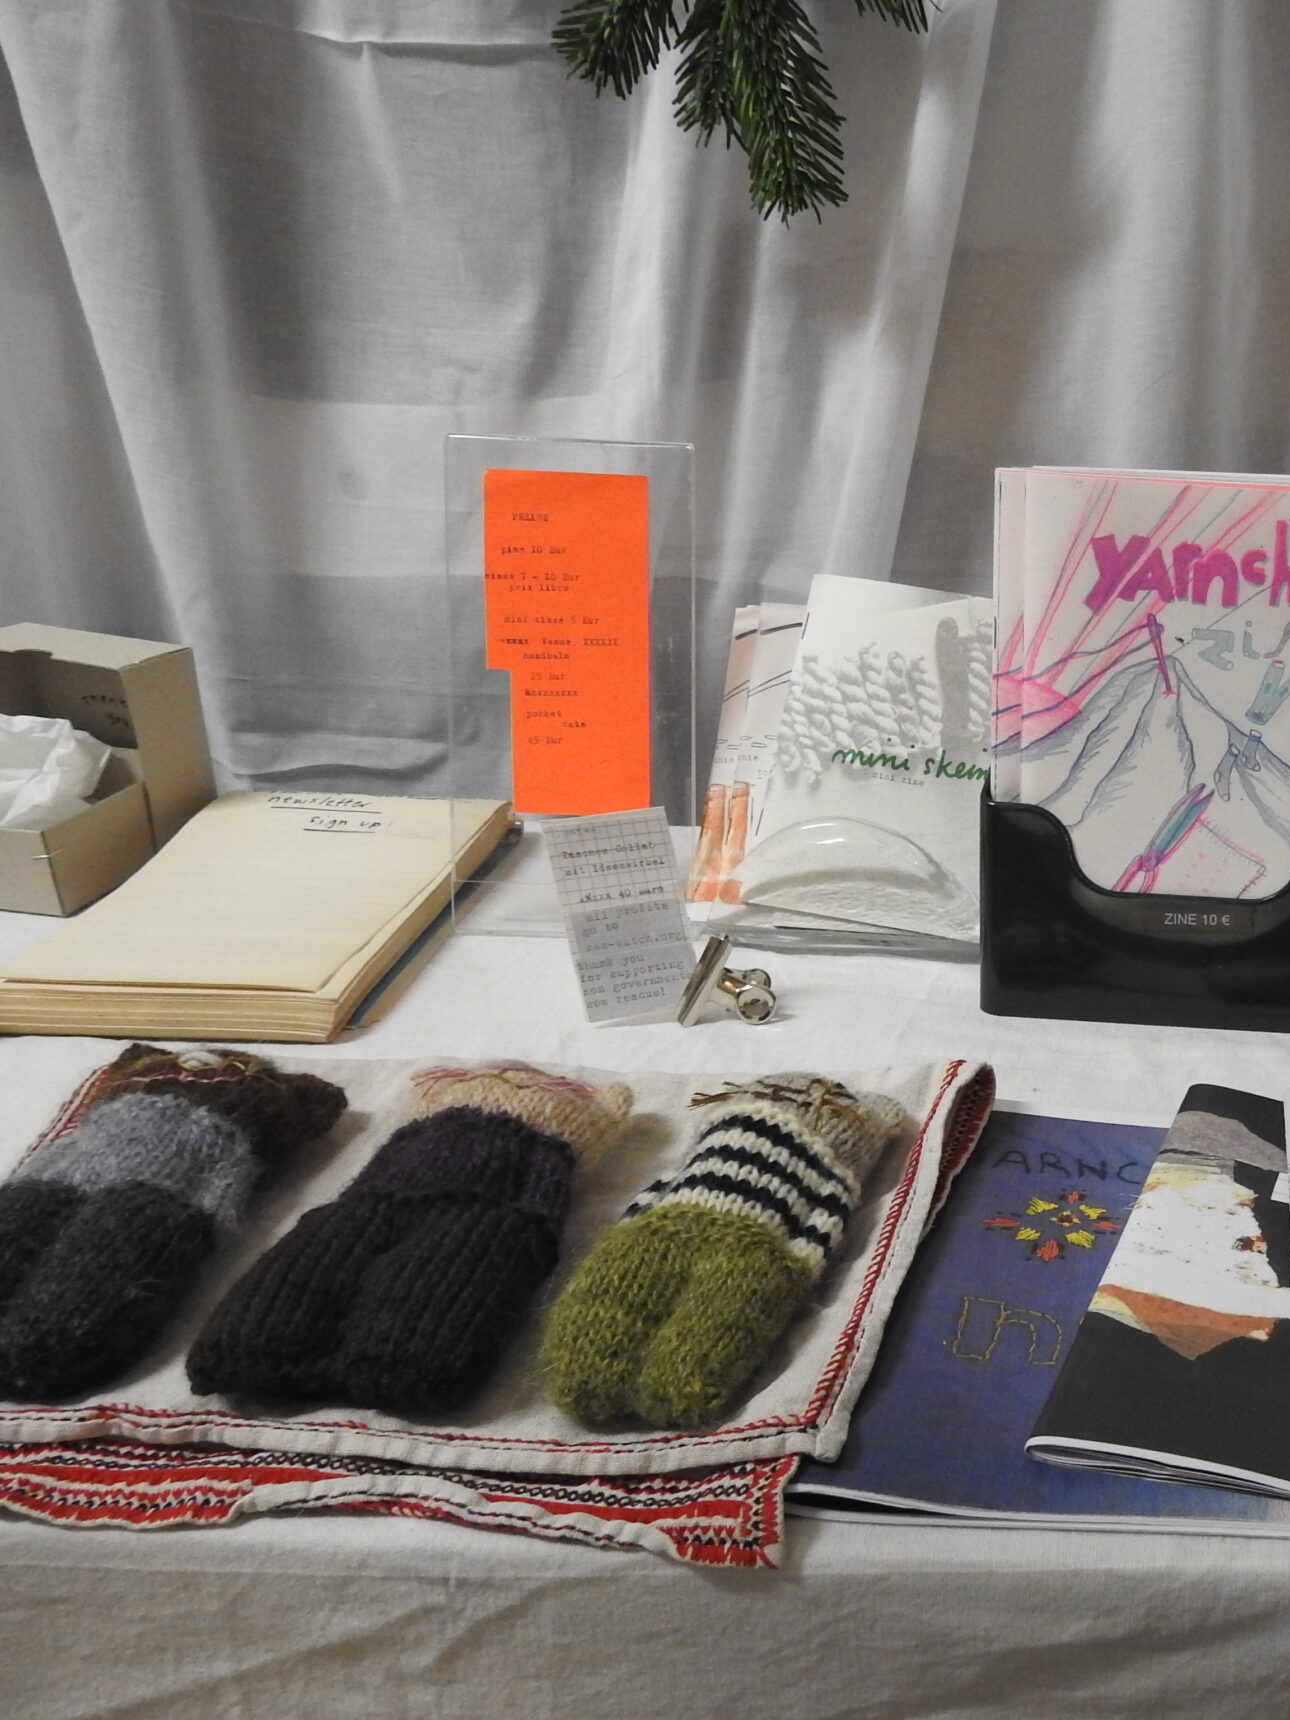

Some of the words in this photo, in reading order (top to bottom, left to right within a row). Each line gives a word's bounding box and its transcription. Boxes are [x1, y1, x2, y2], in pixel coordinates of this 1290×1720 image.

[1164, 913, 1198, 926] ZINE
[1203, 913, 1218, 926] 10
[1220, 914, 1231, 926] €
